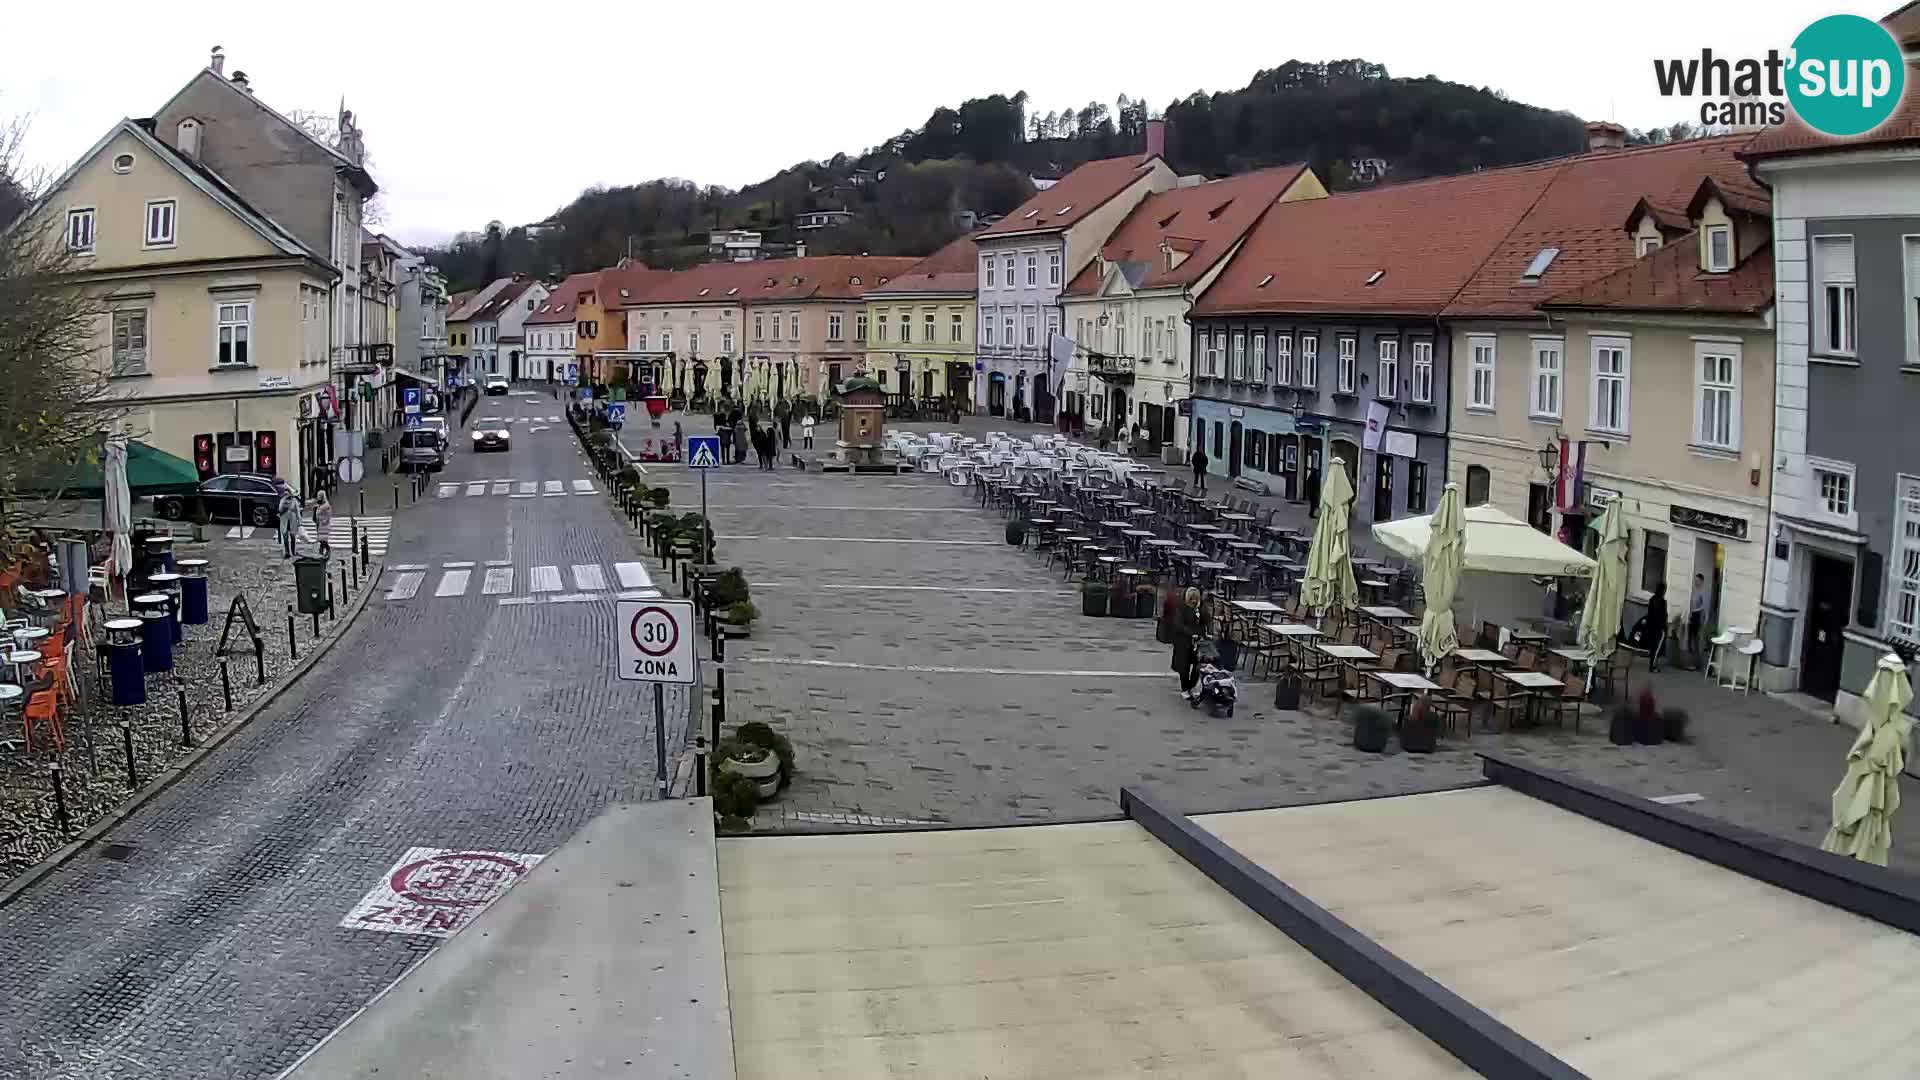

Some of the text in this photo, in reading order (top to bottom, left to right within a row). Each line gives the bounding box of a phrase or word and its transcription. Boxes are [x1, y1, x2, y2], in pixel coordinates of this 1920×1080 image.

[408, 391, 416, 402] P
[643, 622, 667, 643] 30
[633, 659, 678, 676] ZONA
